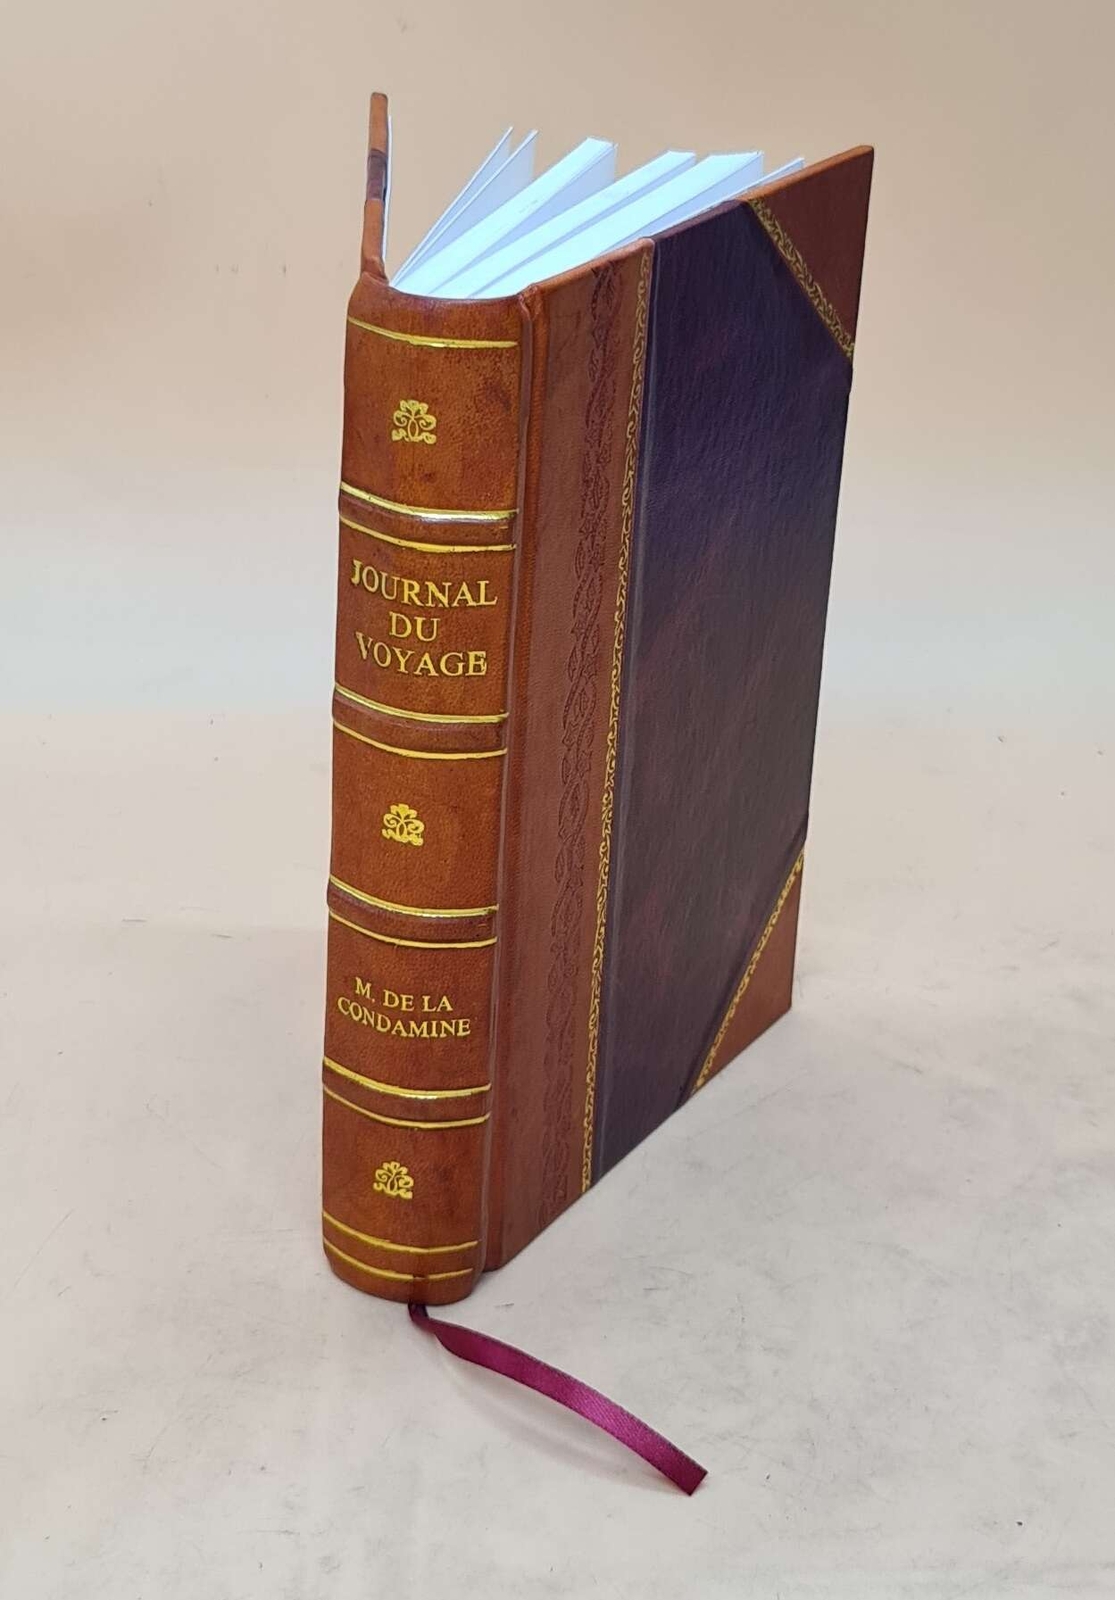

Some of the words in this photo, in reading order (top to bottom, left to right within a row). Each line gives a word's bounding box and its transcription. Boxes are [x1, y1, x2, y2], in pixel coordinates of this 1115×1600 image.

[351, 559, 498, 608] JOURNAL
[389, 611, 441, 642] DU
[355, 632, 487, 677] VOYAGE
[354, 977, 376, 1003] M.
[382, 988, 414, 1012] DE
[421, 994, 453, 1013] LA
[337, 997, 472, 1038] CONDAMINE
